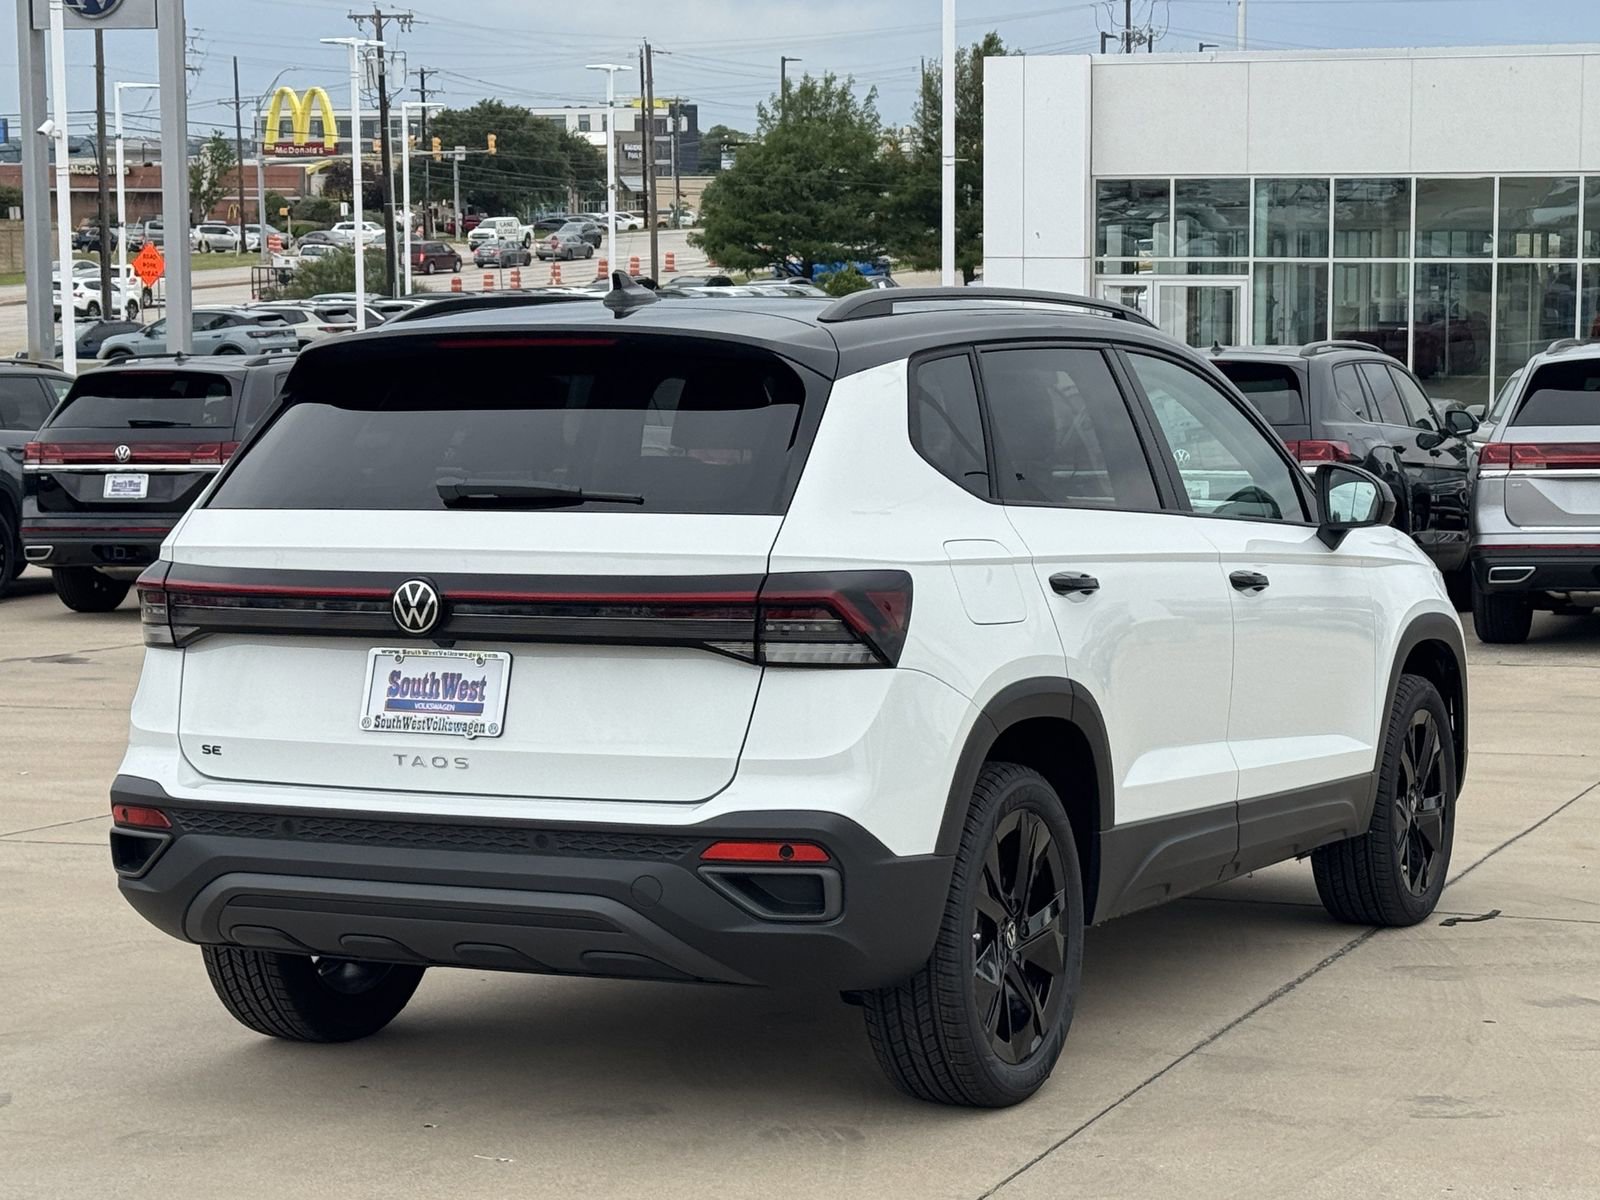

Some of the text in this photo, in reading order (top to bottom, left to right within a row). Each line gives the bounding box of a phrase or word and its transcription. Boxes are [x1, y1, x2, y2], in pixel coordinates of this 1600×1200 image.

[274, 146, 324, 154] McDonald's
[386, 669, 487, 701] SouthWest
[414, 702, 456, 712] VOLKSWAGEN
[373, 714, 486, 735] SouthWestVolkswagen
[201, 744, 222, 756] SE
[393, 753, 470, 770] TAOS
